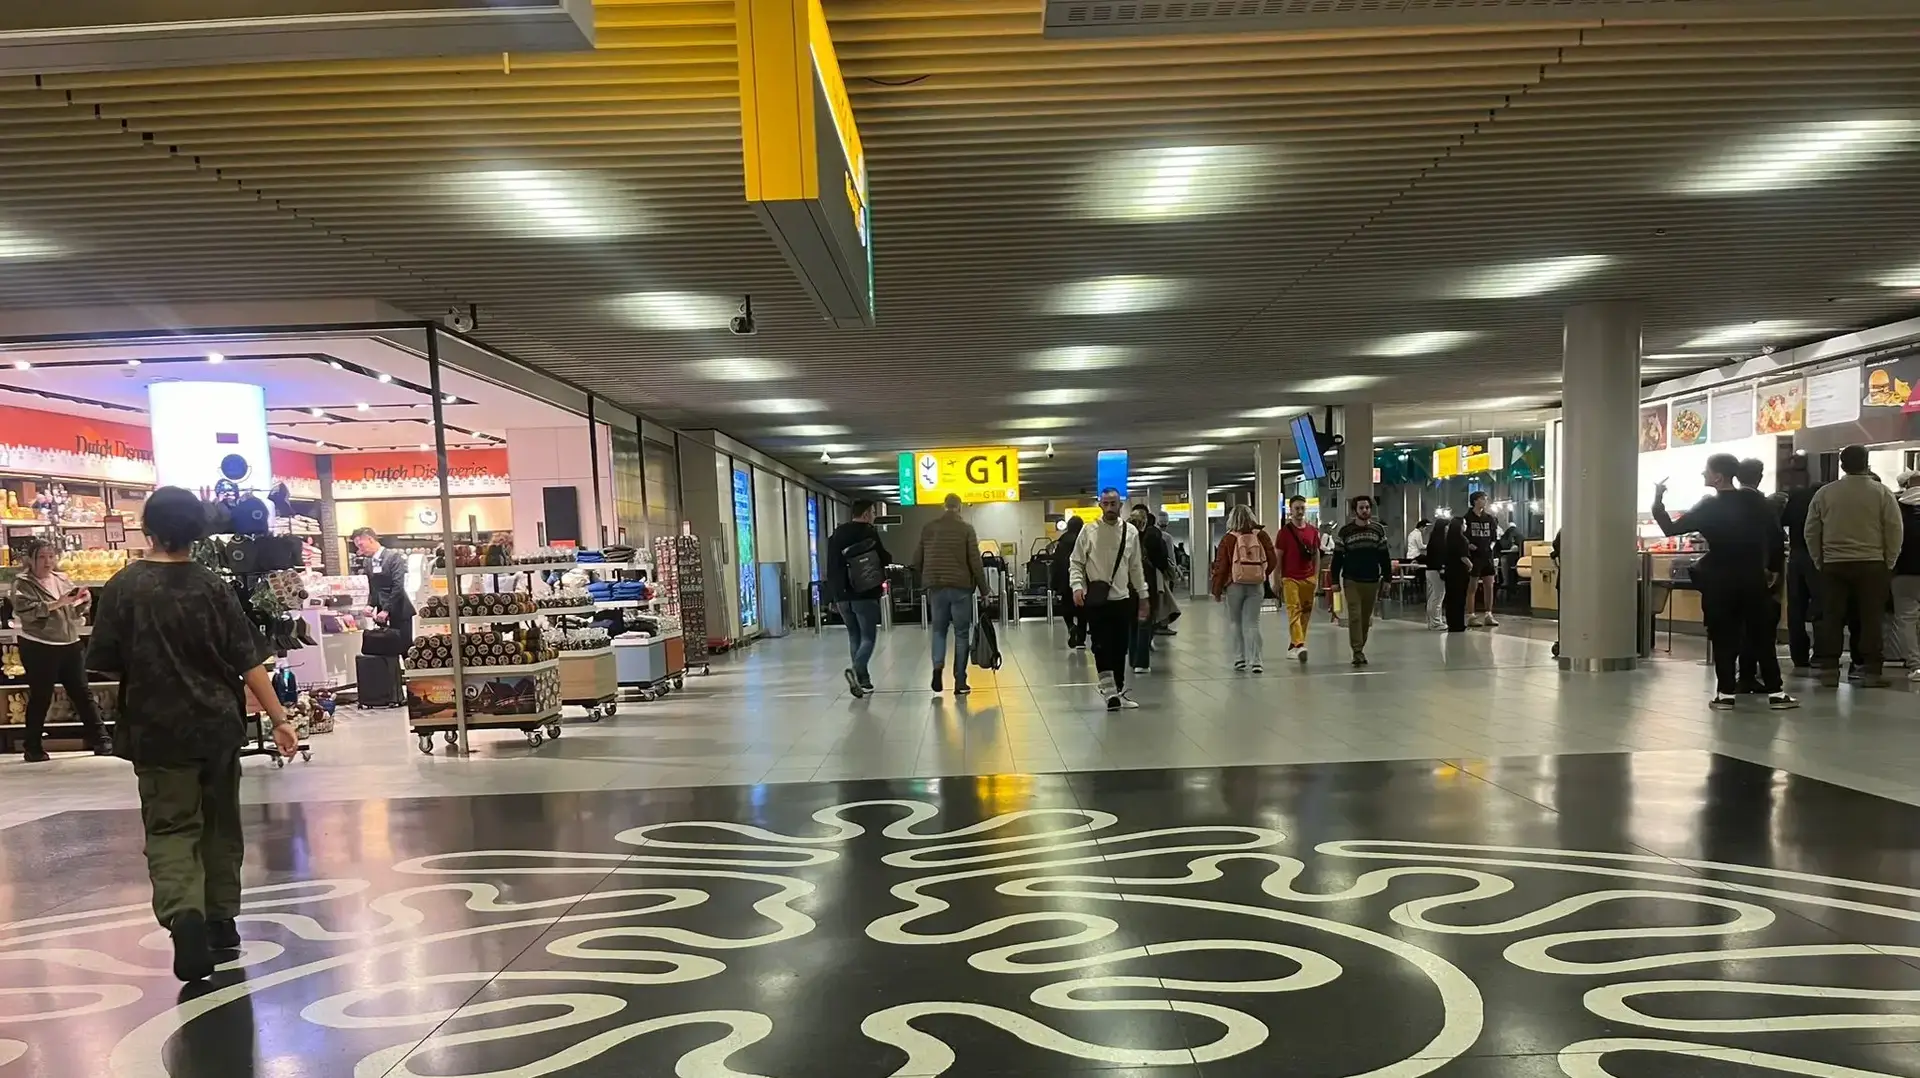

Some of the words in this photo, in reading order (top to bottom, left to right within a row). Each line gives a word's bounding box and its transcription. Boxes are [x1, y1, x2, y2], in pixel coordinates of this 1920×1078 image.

[76, 435, 113, 460] Dutch
[363, 464, 408, 481] Dutch
[412, 462, 488, 480] Disveries
[965, 455, 1008, 484] G1
